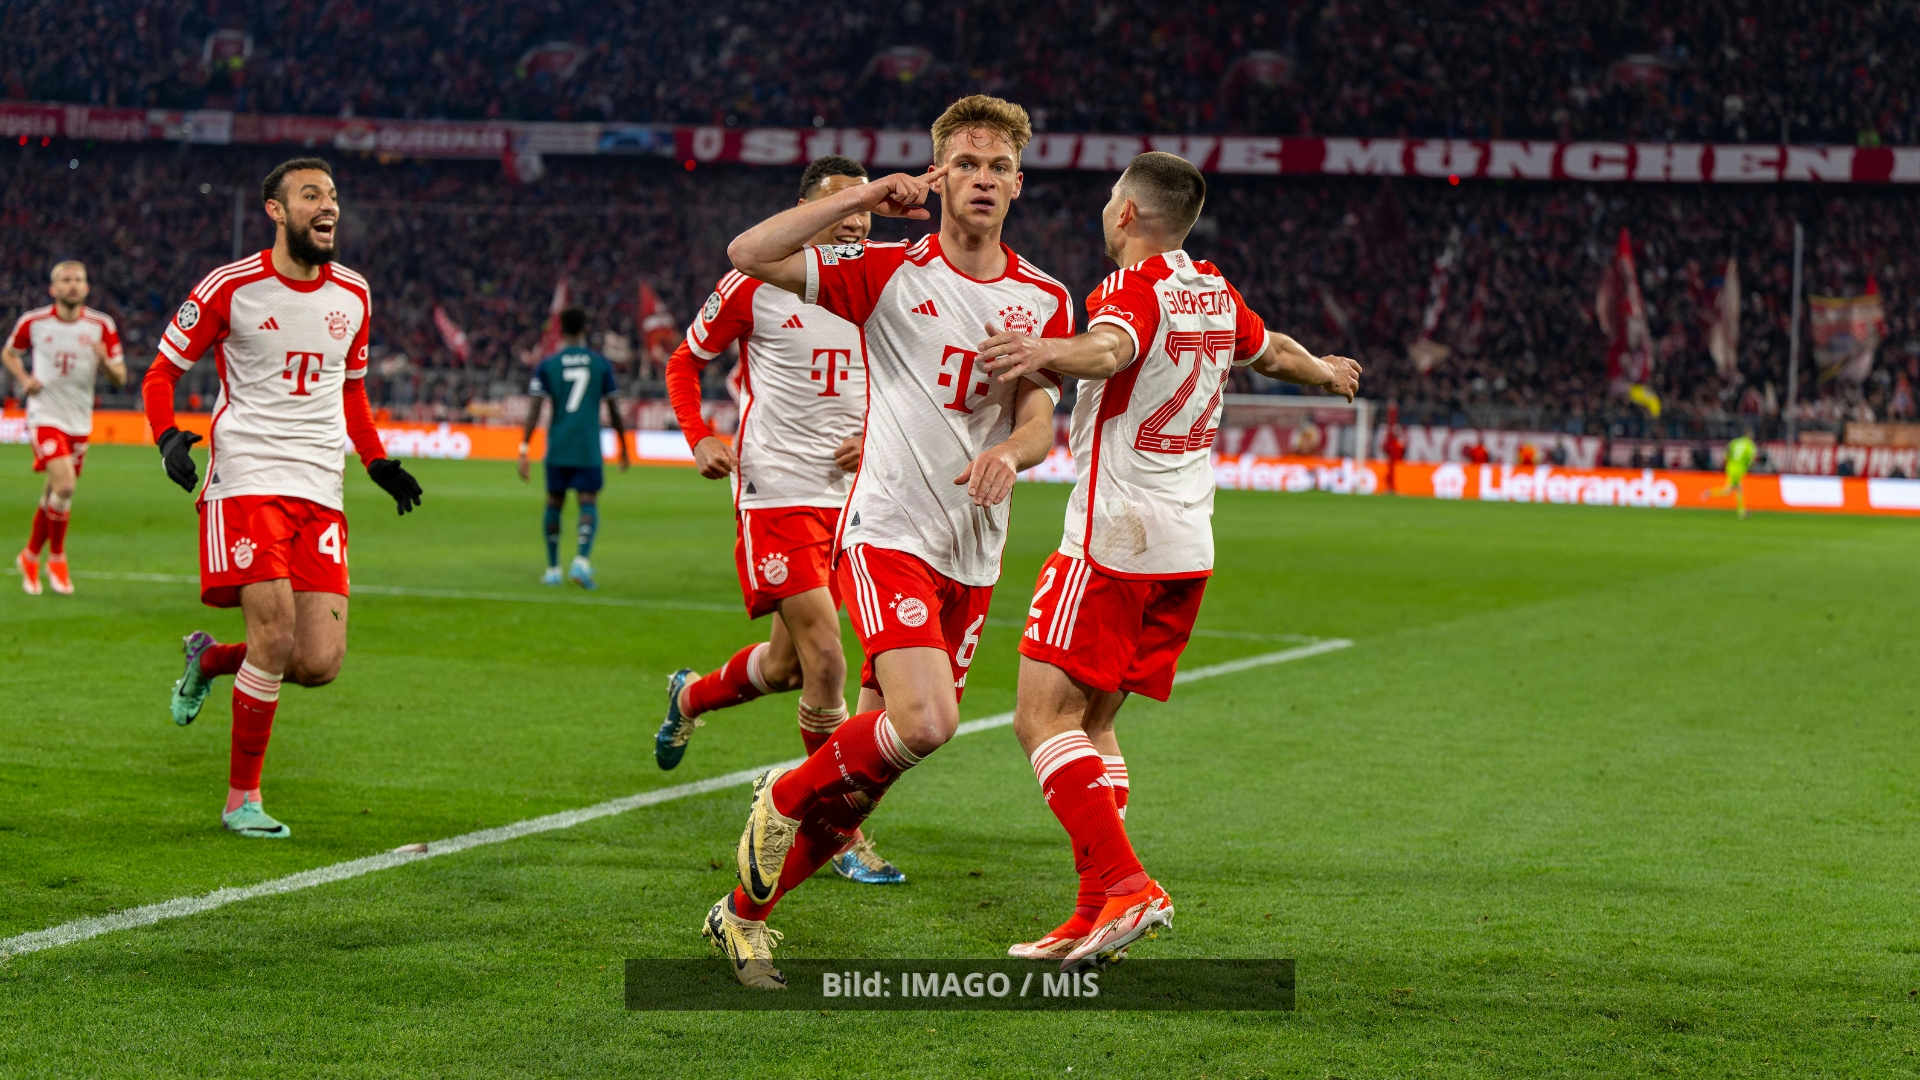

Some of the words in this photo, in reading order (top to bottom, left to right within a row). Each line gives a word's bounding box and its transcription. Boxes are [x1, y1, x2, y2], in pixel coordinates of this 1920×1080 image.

[740, 127, 1284, 175] SÜDURVE
[1321, 137, 1853, 182] MÜNCHEN
[562, 367, 591, 413] 7
[1133, 329, 1235, 454] 22
[1479, 463, 1678, 508] Lieferando
[956, 614, 984, 667] 6
